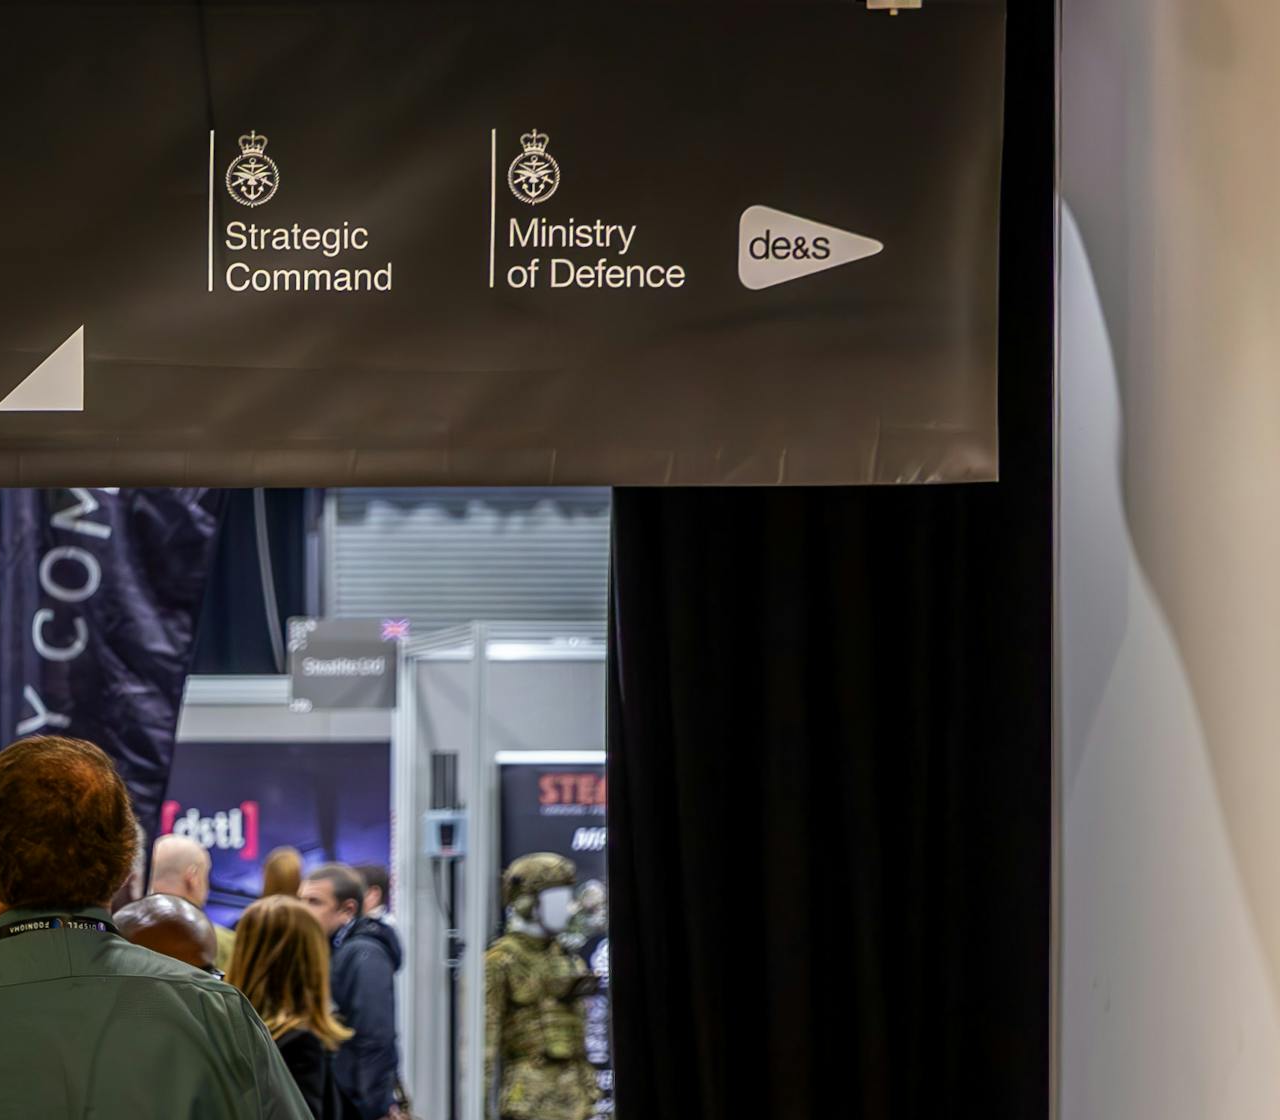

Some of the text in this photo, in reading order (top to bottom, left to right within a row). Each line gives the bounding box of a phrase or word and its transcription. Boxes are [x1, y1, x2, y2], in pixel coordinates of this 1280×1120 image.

[224, 221, 370, 258] Strategic
[508, 217, 638, 255] Ministry
[748, 228, 832, 261] de&s
[224, 262, 393, 292] Command
[507, 257, 686, 289] of Defence
